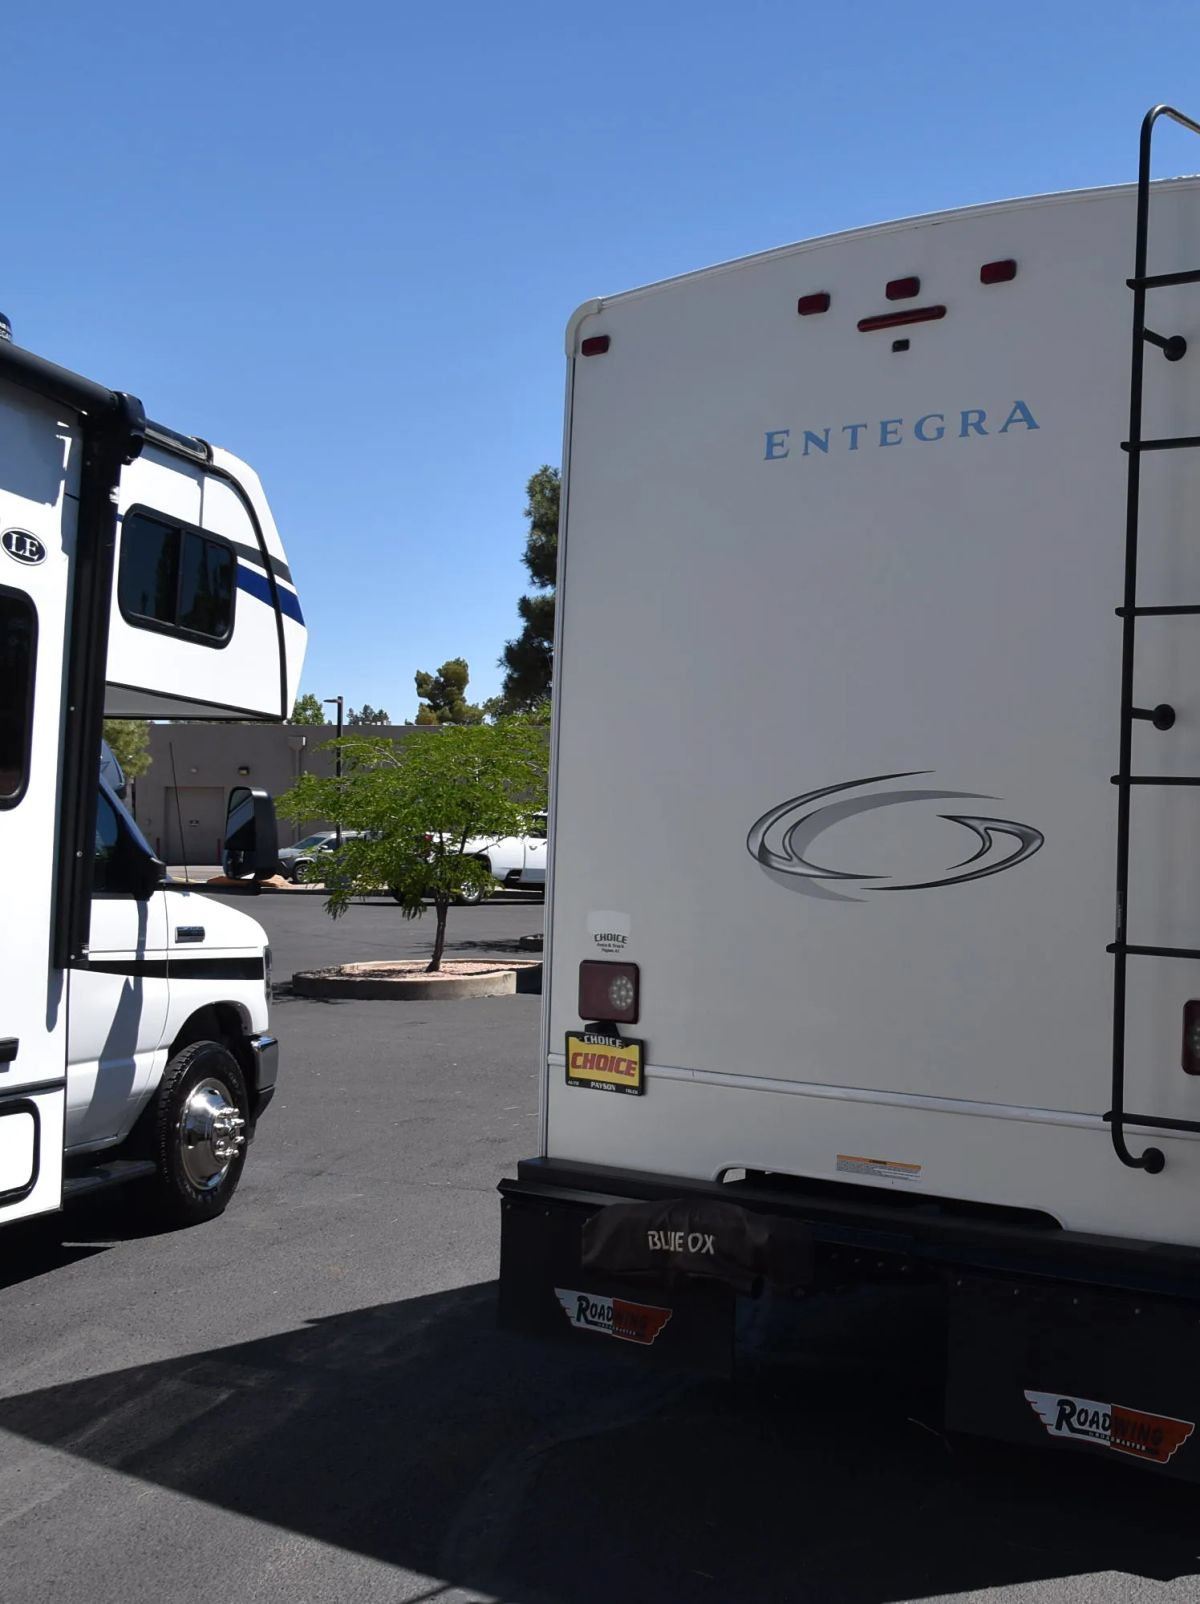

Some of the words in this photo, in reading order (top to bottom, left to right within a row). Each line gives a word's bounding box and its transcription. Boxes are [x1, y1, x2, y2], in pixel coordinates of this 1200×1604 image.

[763, 399, 1041, 461] ENTEGRA
[8, 532, 39, 561] LE
[594, 933, 629, 945] CHOICE
[584, 1035, 623, 1049] CHOICE
[571, 1052, 638, 1077] CHOICE
[590, 1081, 616, 1092] PAYSON
[647, 1230, 685, 1252] BLUE
[687, 1232, 715, 1255] OX
